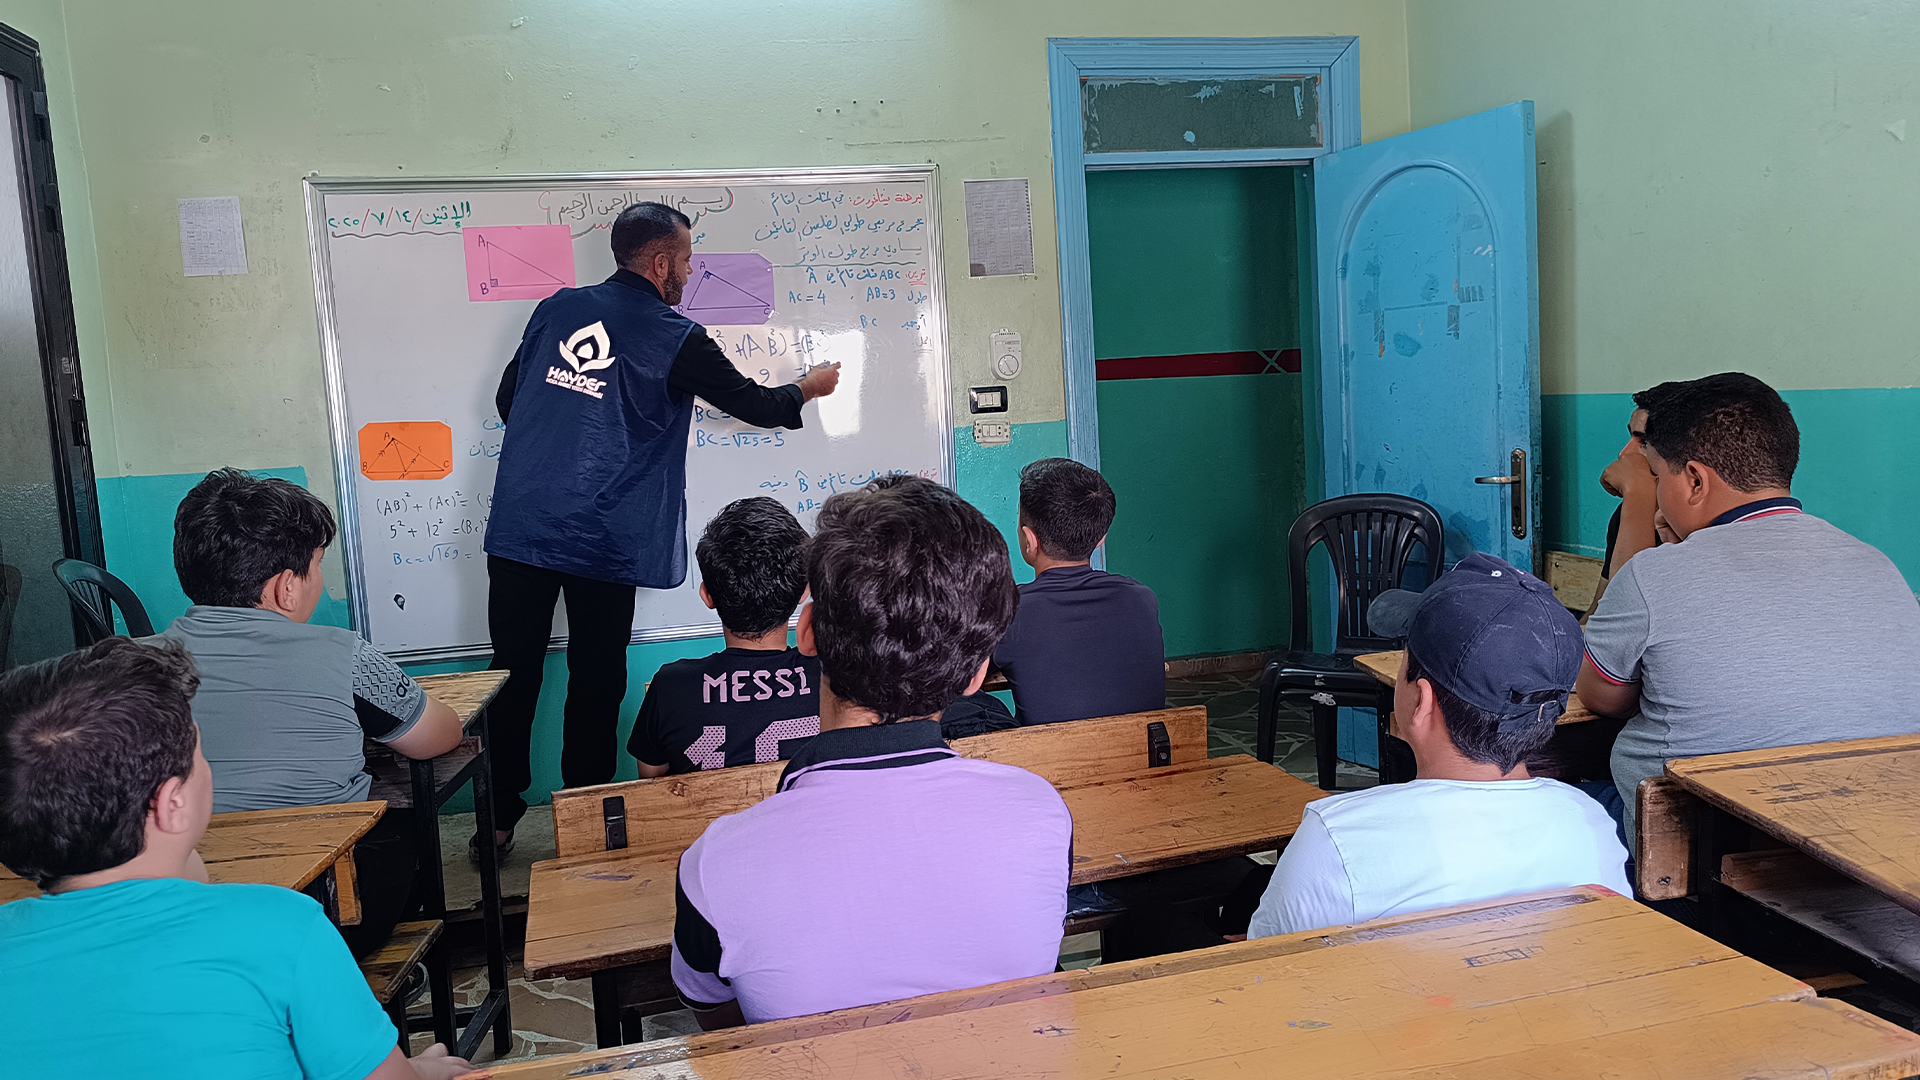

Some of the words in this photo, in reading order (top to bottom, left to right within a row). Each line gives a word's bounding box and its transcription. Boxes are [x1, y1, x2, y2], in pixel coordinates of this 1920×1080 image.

[478, 234, 486, 247] A
[700, 260, 706, 270] A
[879, 269, 901, 281] ABC
[480, 282, 489, 295] B
[384, 431, 391, 441] A
[703, 666, 811, 703] MESSI
